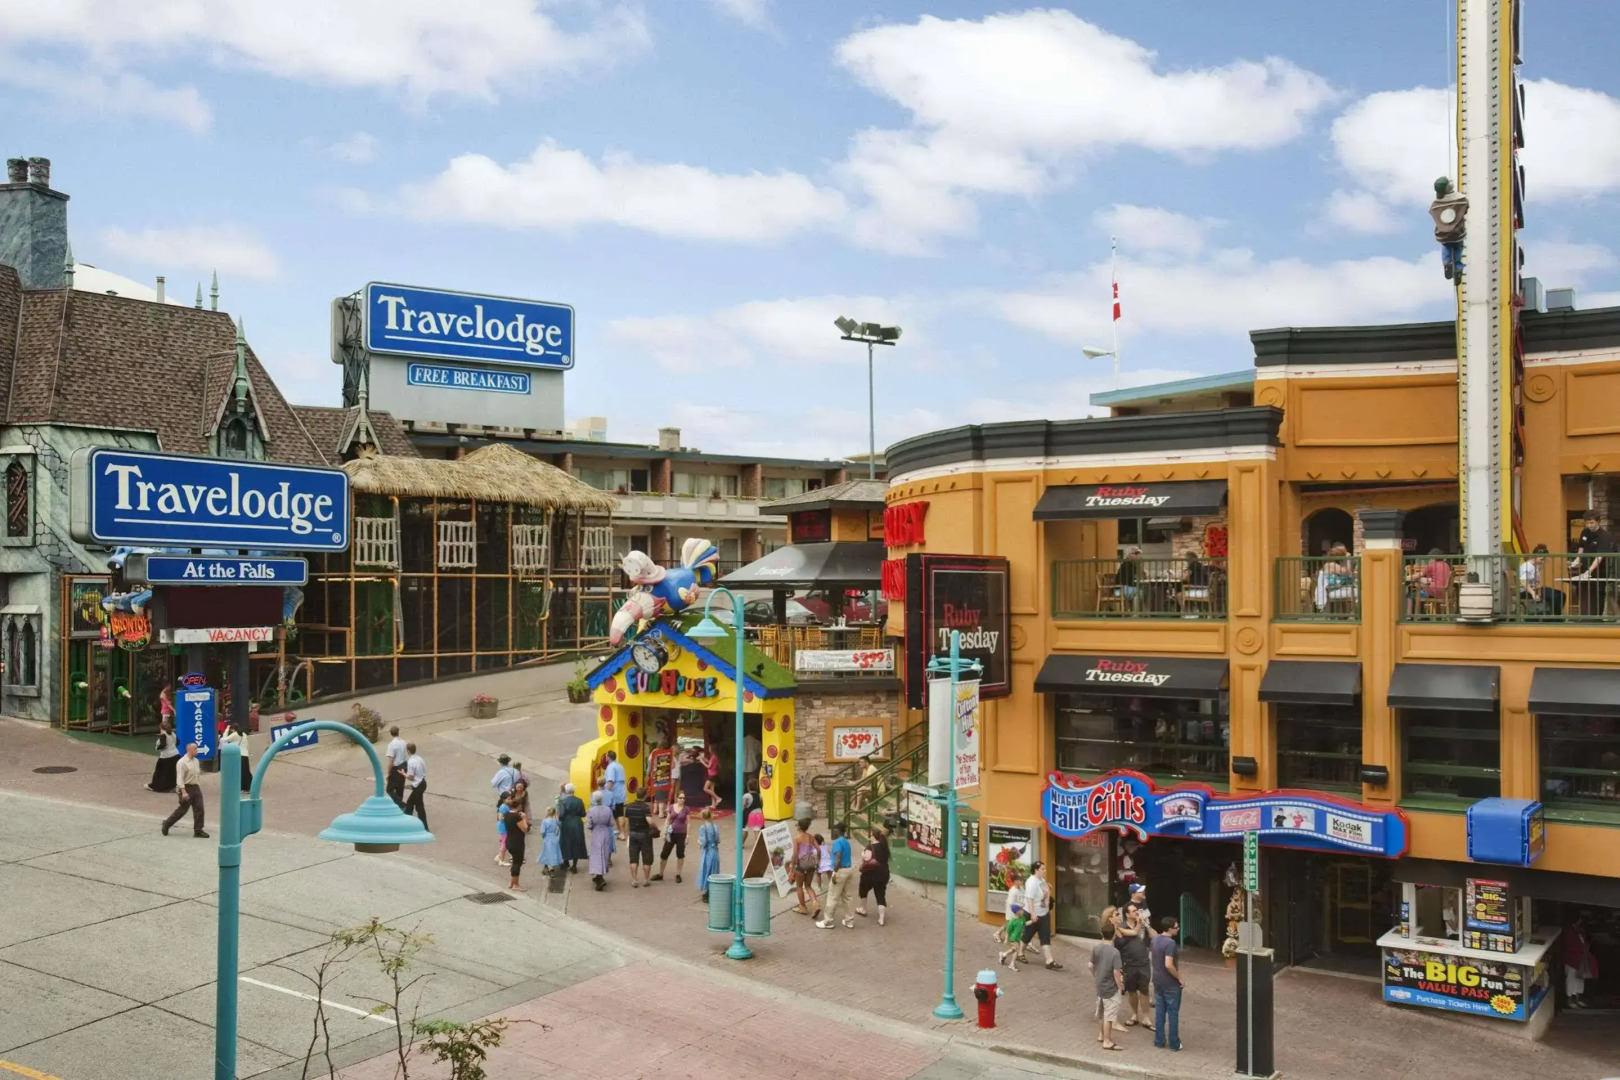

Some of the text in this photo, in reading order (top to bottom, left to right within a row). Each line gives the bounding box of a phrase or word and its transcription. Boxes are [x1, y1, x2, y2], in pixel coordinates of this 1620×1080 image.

[377, 294, 562, 356] Travelodge
[414, 367, 526, 391] FREE BREAKFAST
[104, 463, 333, 535] Travelodge
[1085, 495, 1171, 507] Tuesday
[1096, 486, 1148, 498] Ruby
[182, 561, 275, 579] At the Falls
[943, 603, 981, 632] Ruby
[208, 628, 270, 642] VACANCY
[852, 651, 885, 669] $3.99
[1096, 659, 1148, 674] Ruby
[184, 676, 206, 685] OPEN
[625, 667, 717, 698] FUN HOUSE
[1085, 669, 1171, 686] Tuesday
[194, 701, 203, 746] VACANCY
[842, 733, 872, 749] $3.99
[1051, 779, 1145, 826] NIAGARA Gifts
[1051, 803, 1089, 829] Falls
[1332, 818, 1362, 832] Kodak
[1249, 834, 1257, 855] PAY
[1482, 892, 1499, 901] BIG
[1402, 966, 1425, 980] The
[1426, 961, 1480, 987] BIG
[1481, 976, 1503, 990] Fun
[1417, 981, 1457, 995] VALUE
[1460, 986, 1490, 999] PASS
[1416, 995, 1446, 1005] Purchase
[1448, 999, 1471, 1009] Tickets
